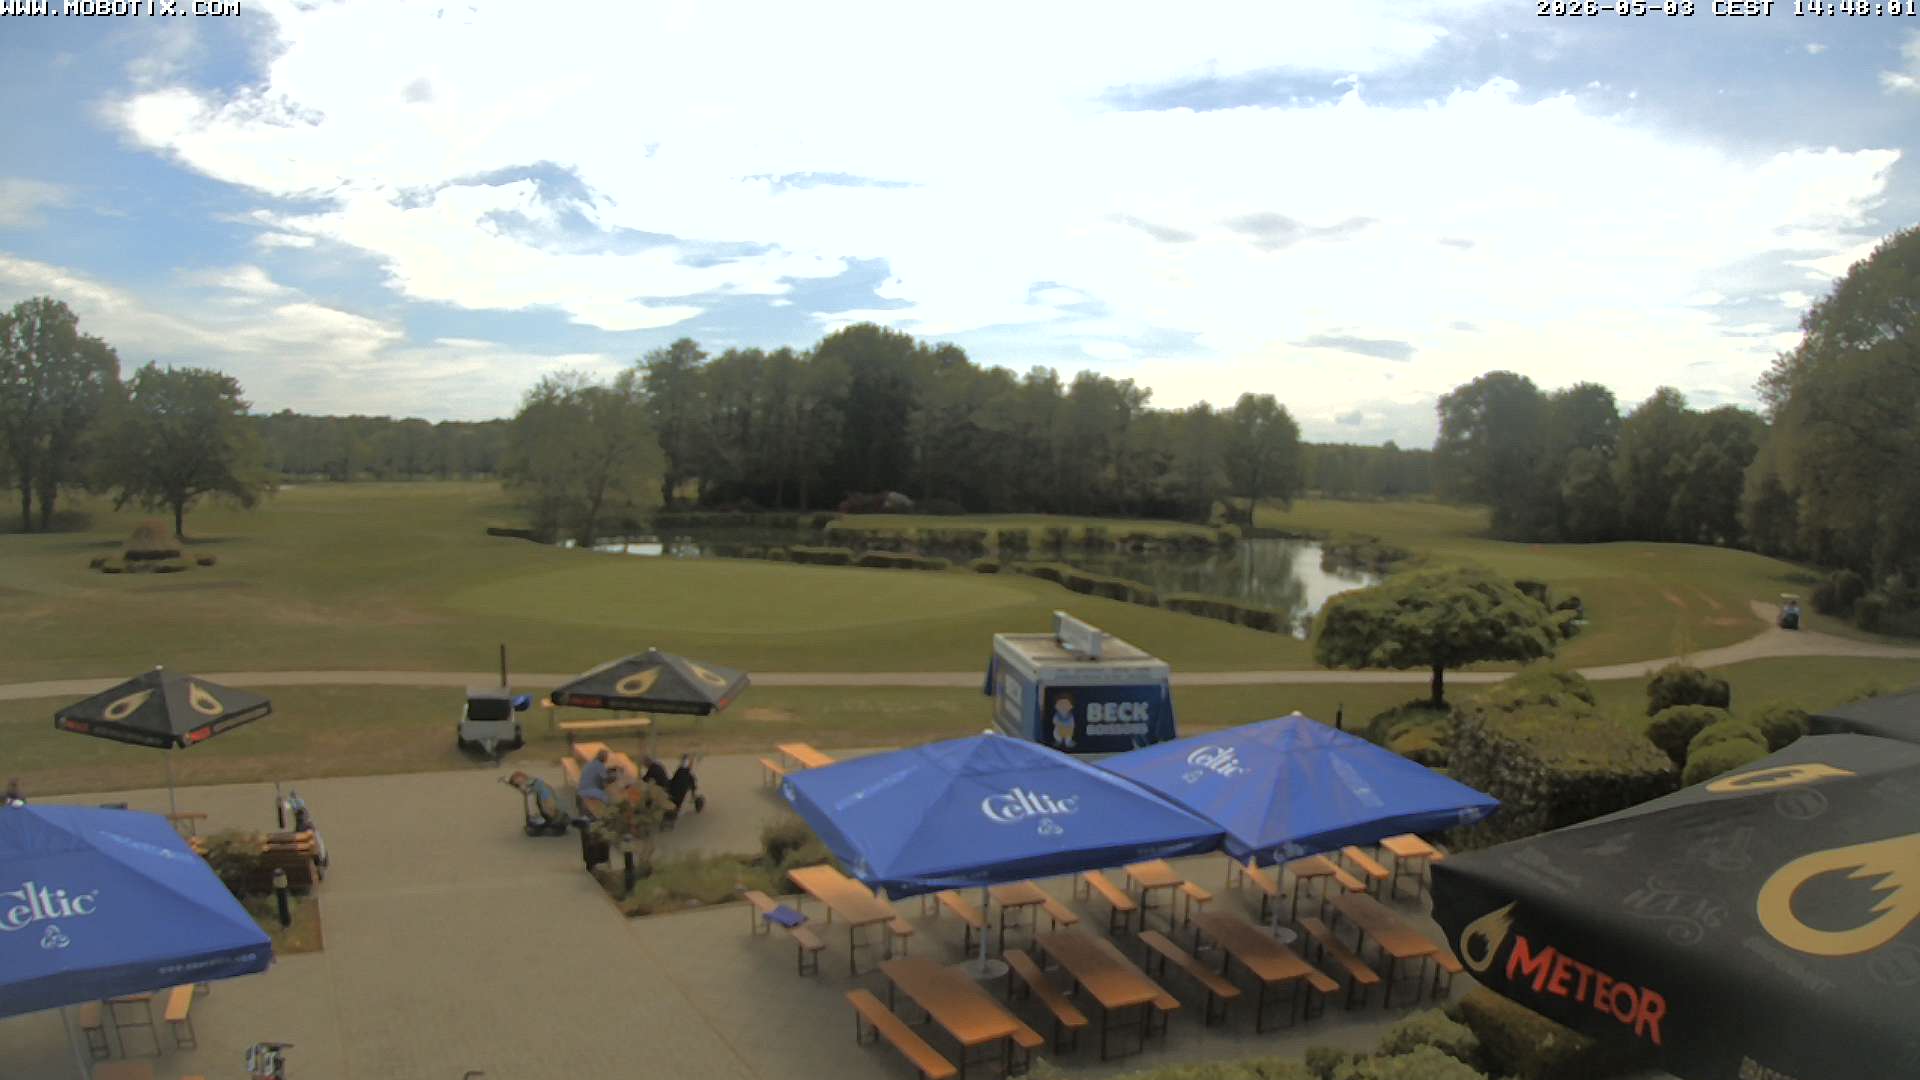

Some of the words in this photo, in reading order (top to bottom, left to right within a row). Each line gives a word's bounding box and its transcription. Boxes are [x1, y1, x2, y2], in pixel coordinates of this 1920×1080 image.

[1086, 701, 1149, 722] BECK
[1187, 744, 1245, 777] Celtic
[981, 786, 1078, 824] Celtic
[1505, 934, 1667, 1047] METEOR
